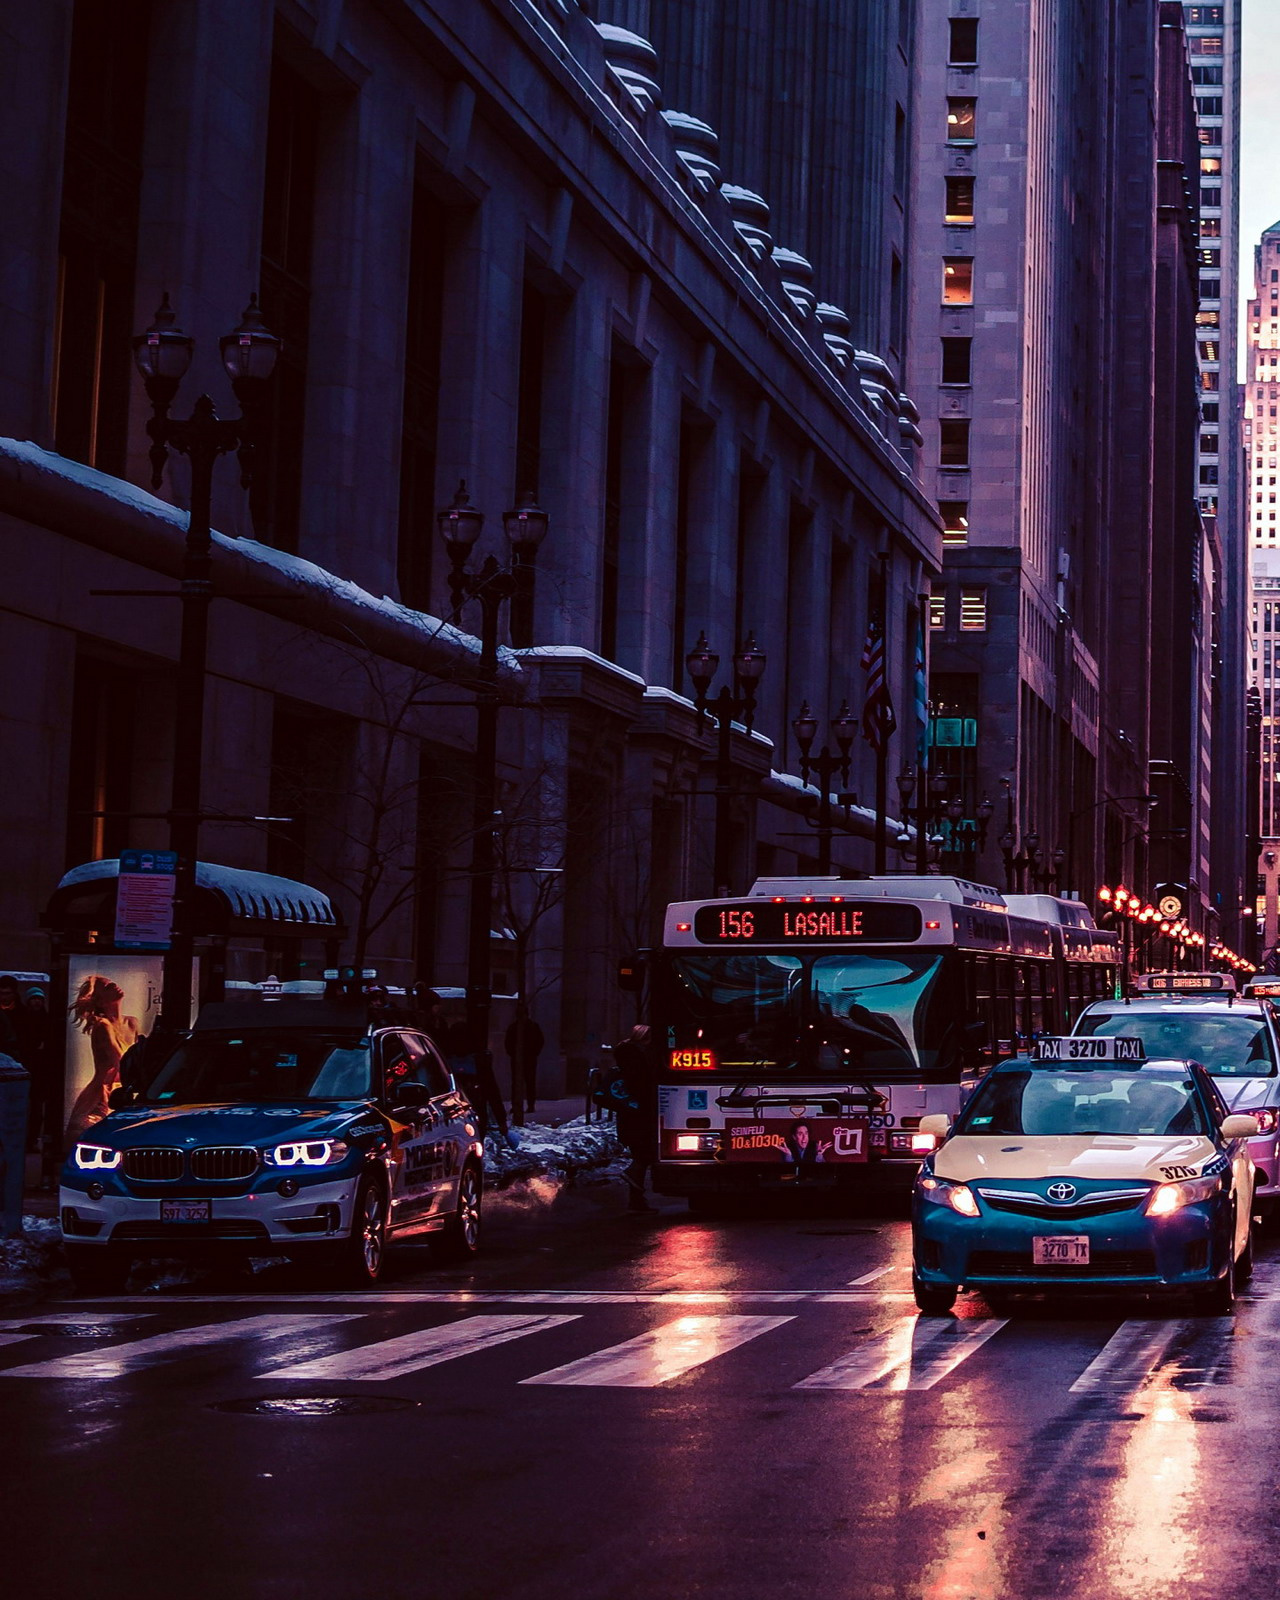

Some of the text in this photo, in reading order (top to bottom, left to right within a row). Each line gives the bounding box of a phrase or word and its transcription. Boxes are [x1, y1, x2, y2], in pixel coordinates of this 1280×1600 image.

[719, 911, 863, 938] 156 LASALLE
[667, 1025, 675, 1035] K
[1038, 1039, 1140, 1058] TAXI 3270 TAXI
[672, 1052, 711, 1068] K915
[730, 1125, 765, 1136] SEINFELD
[1042, 1243, 1087, 1257] 3270 TX
